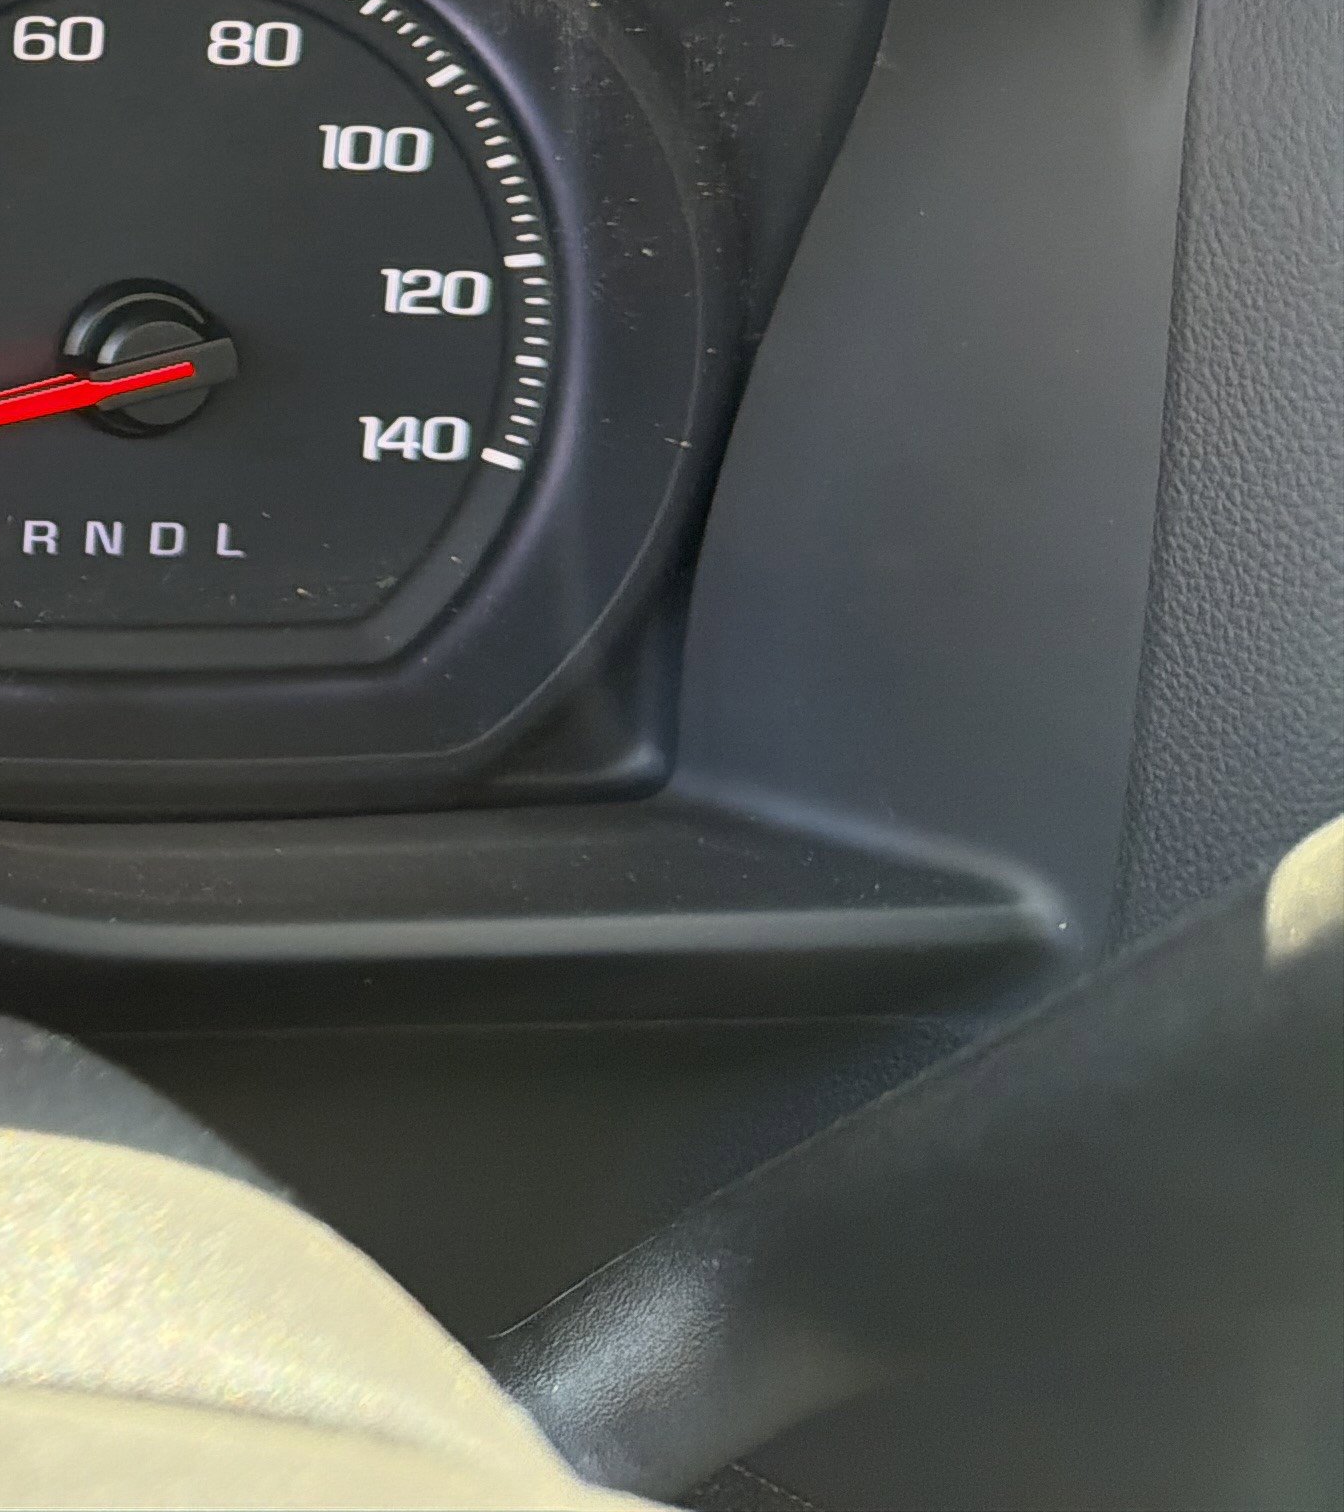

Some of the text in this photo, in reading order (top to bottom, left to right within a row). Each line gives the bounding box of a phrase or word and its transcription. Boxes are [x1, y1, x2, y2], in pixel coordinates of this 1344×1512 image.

[13, 15, 105, 62] 60
[207, 20, 302, 67] 80
[318, 124, 432, 173] 100
[380, 268, 491, 316] 120
[358, 416, 470, 461] 140
[22, 519, 58, 555] R
[84, 520, 123, 556] N
[149, 521, 185, 556] D
[216, 522, 244, 558] L
